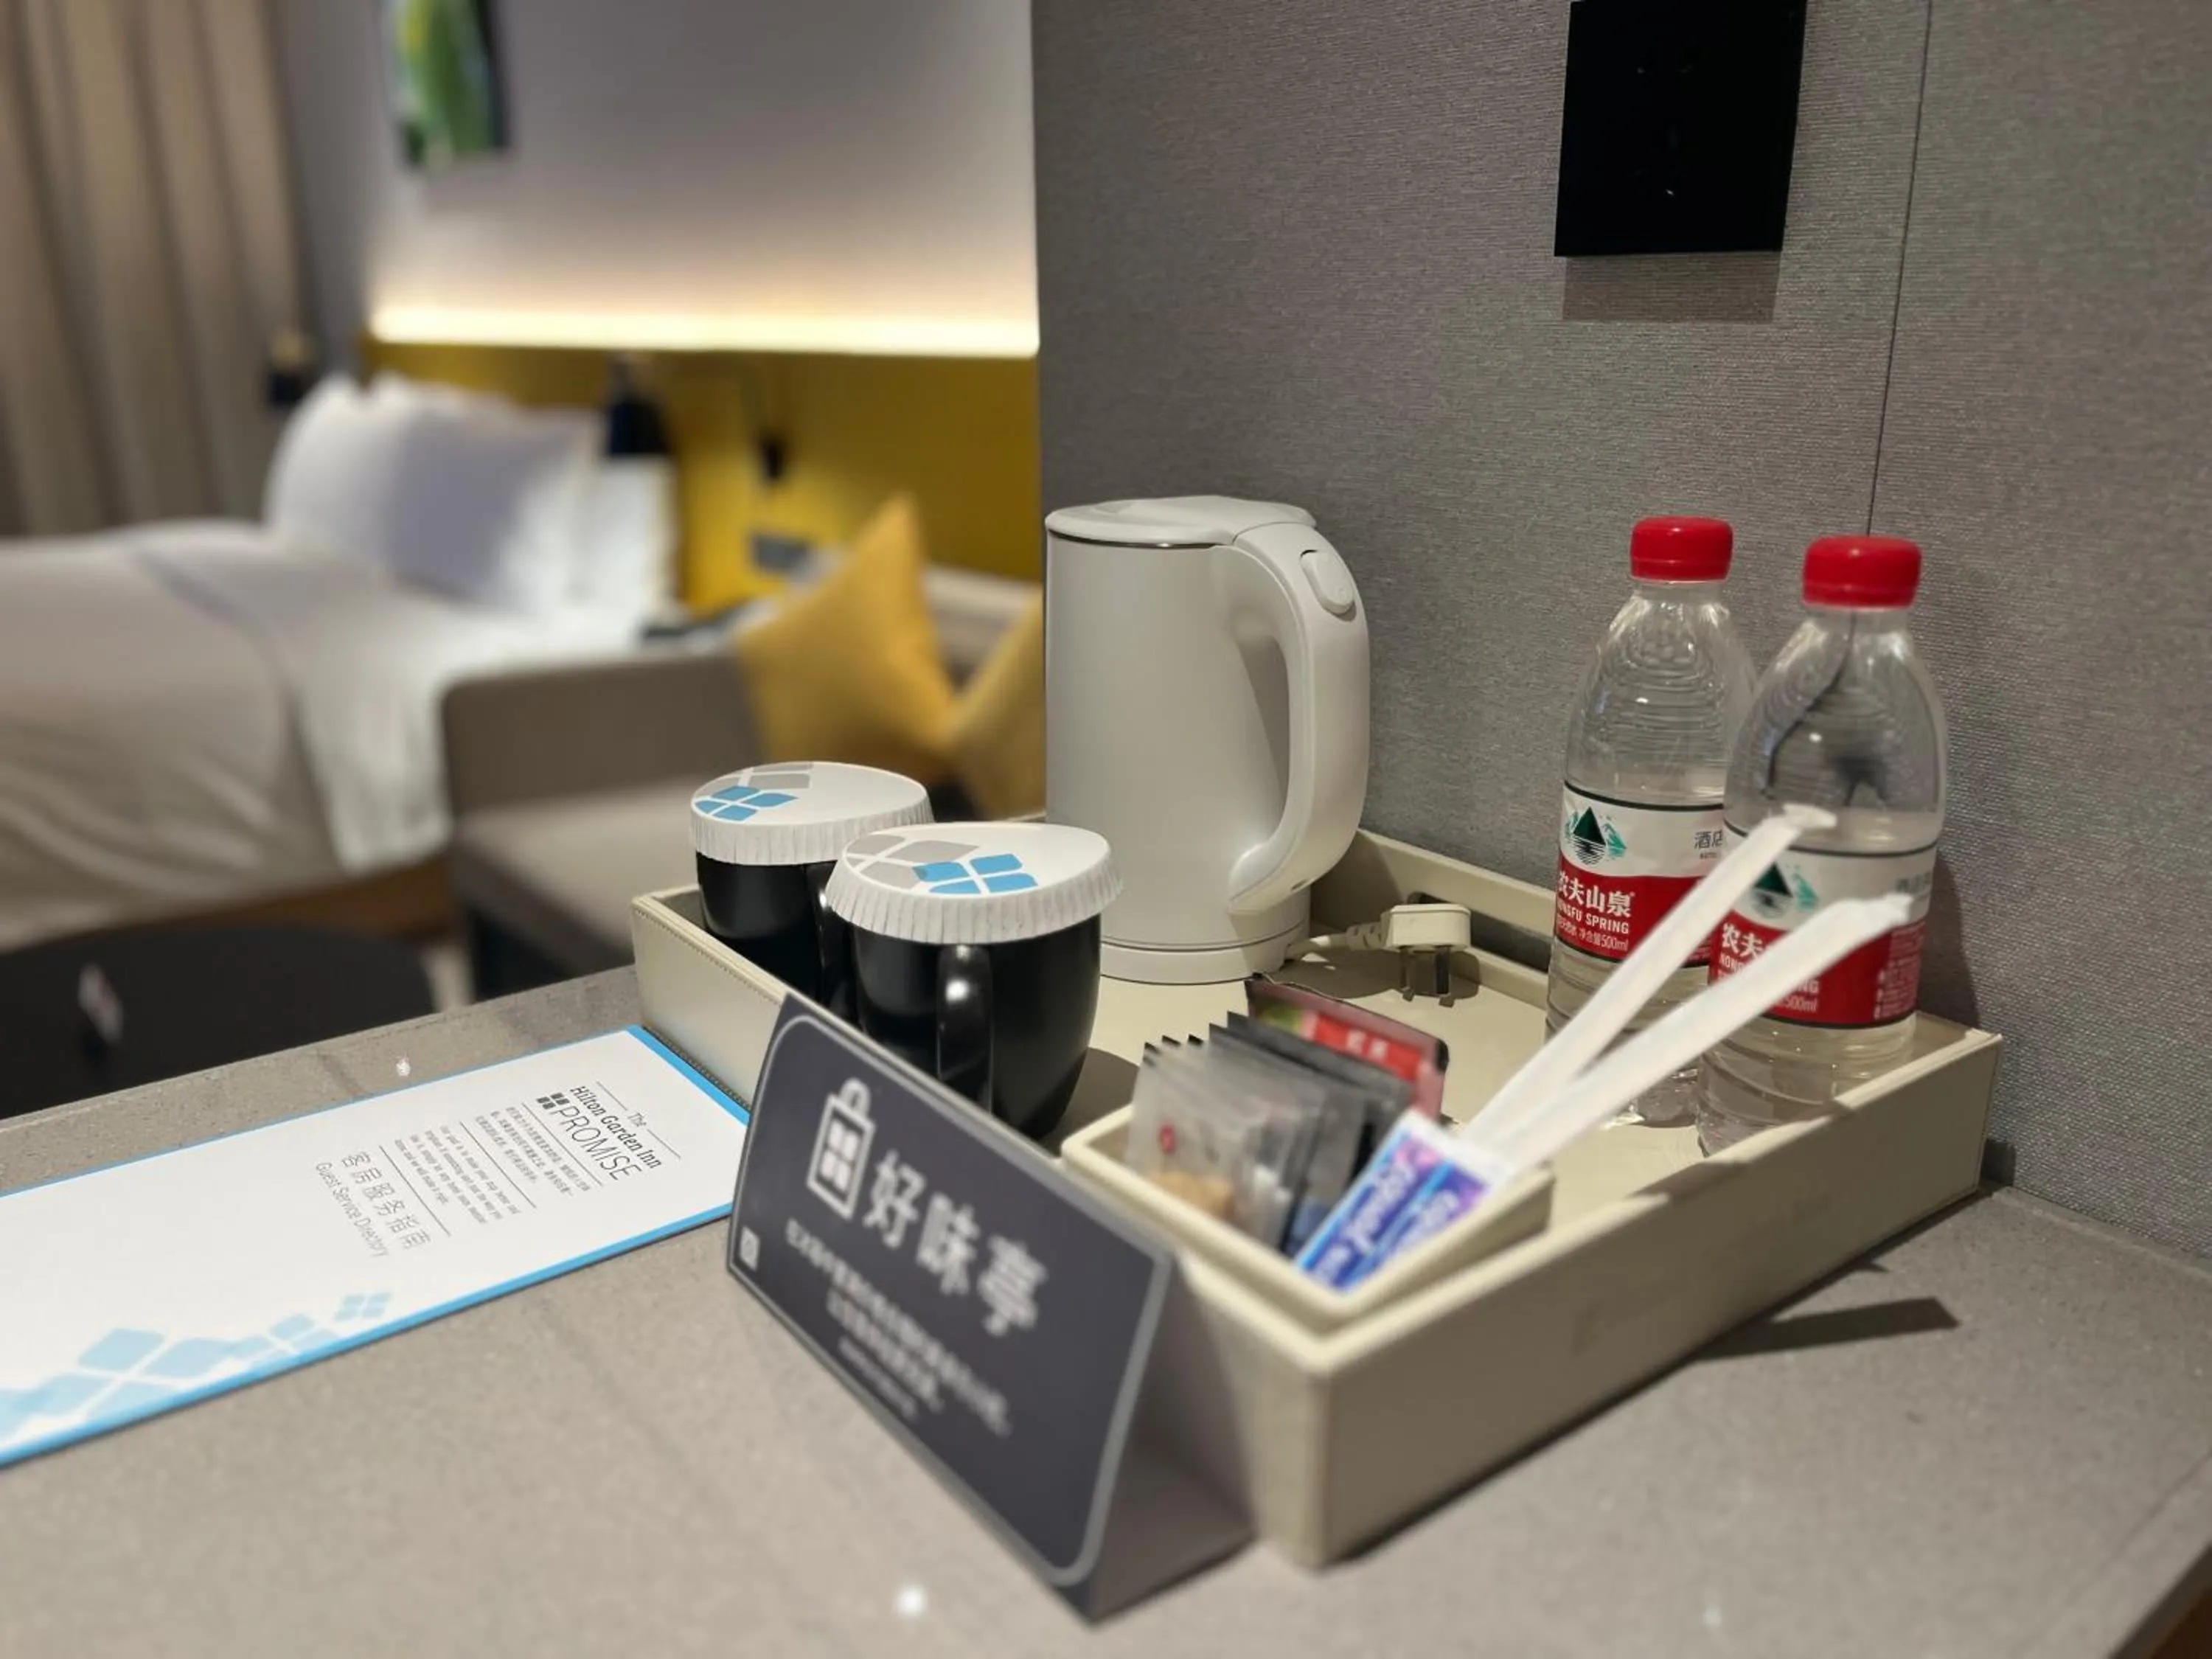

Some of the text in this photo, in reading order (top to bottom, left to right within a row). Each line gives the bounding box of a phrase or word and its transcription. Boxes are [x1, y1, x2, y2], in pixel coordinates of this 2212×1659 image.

[1585, 913, 1630, 934] SPRING
[1722, 923, 1764, 959] 农夫
[549, 1106, 642, 1180] PROMISE
[569, 1086, 661, 1169] Hilton Garden Inn
[627, 1112, 647, 1127] The
[316, 1163, 341, 1188] Guest
[333, 1186, 362, 1218] Service
[341, 1152, 431, 1249] 客房服务指南
